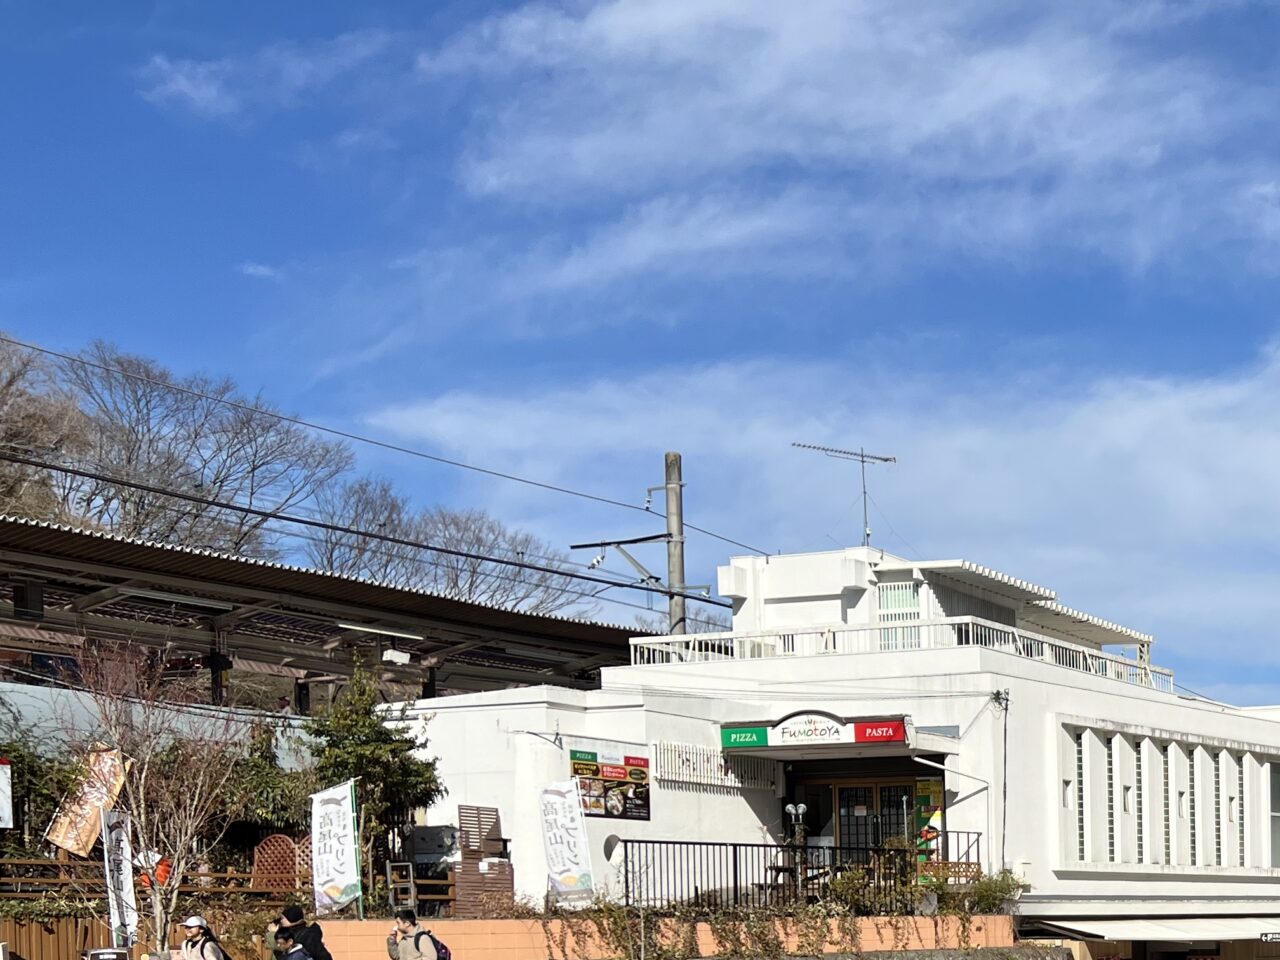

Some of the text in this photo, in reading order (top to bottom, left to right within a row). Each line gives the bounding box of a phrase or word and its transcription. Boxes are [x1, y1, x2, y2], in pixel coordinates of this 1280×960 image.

[865, 727, 894, 737] PASTA
[730, 733, 758, 742] PIZZA
[576, 752, 592, 760] PIZZA
